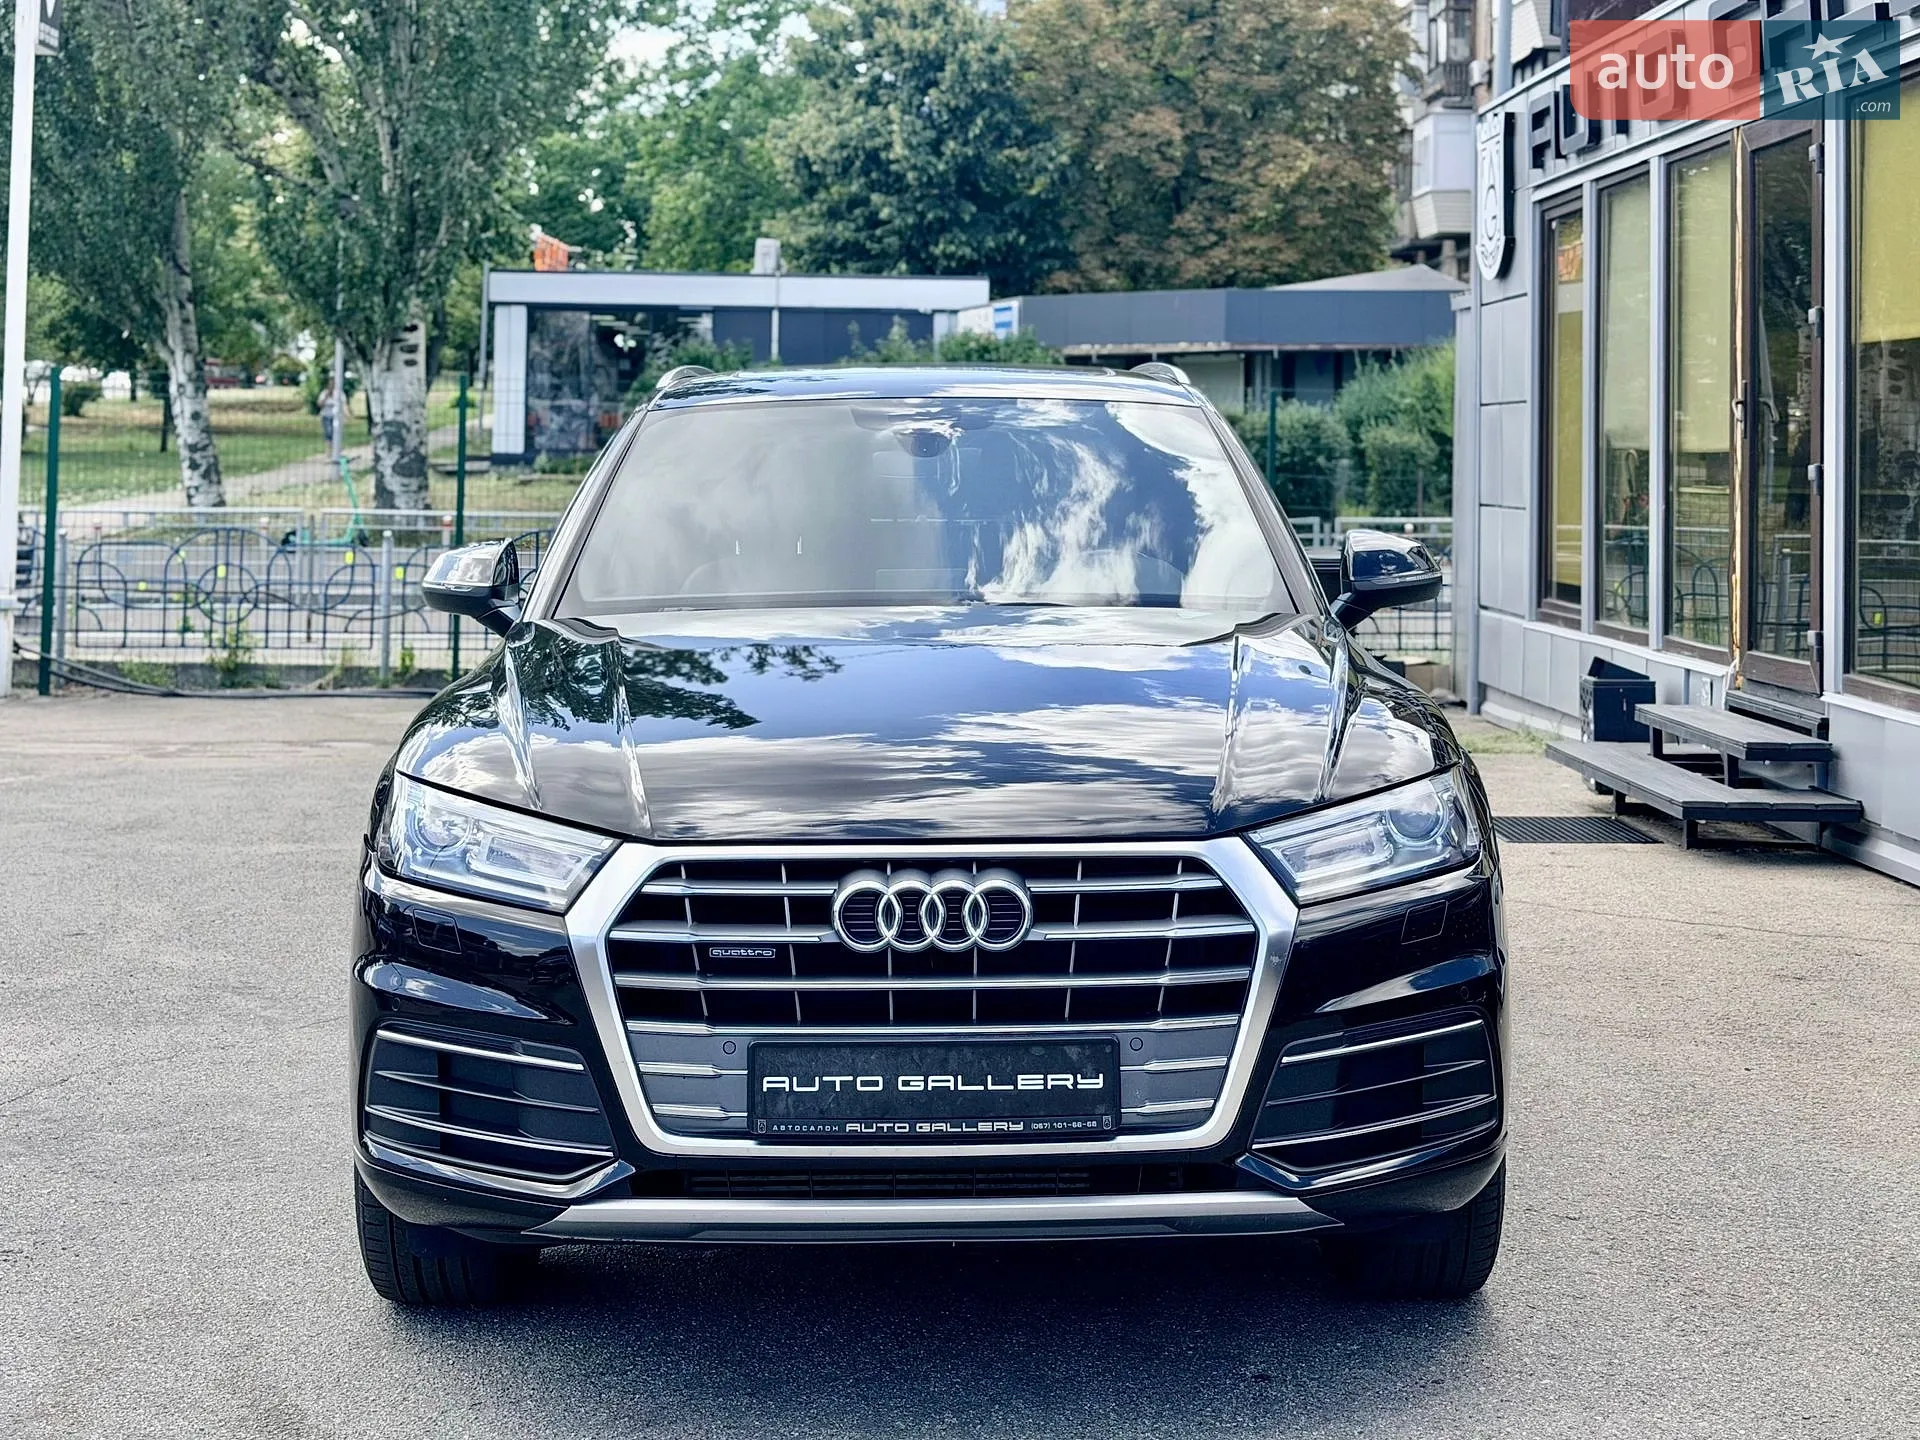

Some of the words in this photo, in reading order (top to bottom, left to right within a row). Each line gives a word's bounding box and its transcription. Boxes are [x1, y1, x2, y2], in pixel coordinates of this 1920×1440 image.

[712, 949, 773, 957] quattro
[763, 1076, 883, 1092] AUTO
[898, 1073, 1104, 1091] GALLERY
[846, 1123, 910, 1133] AUTO
[916, 1121, 1024, 1133] GALLERY
